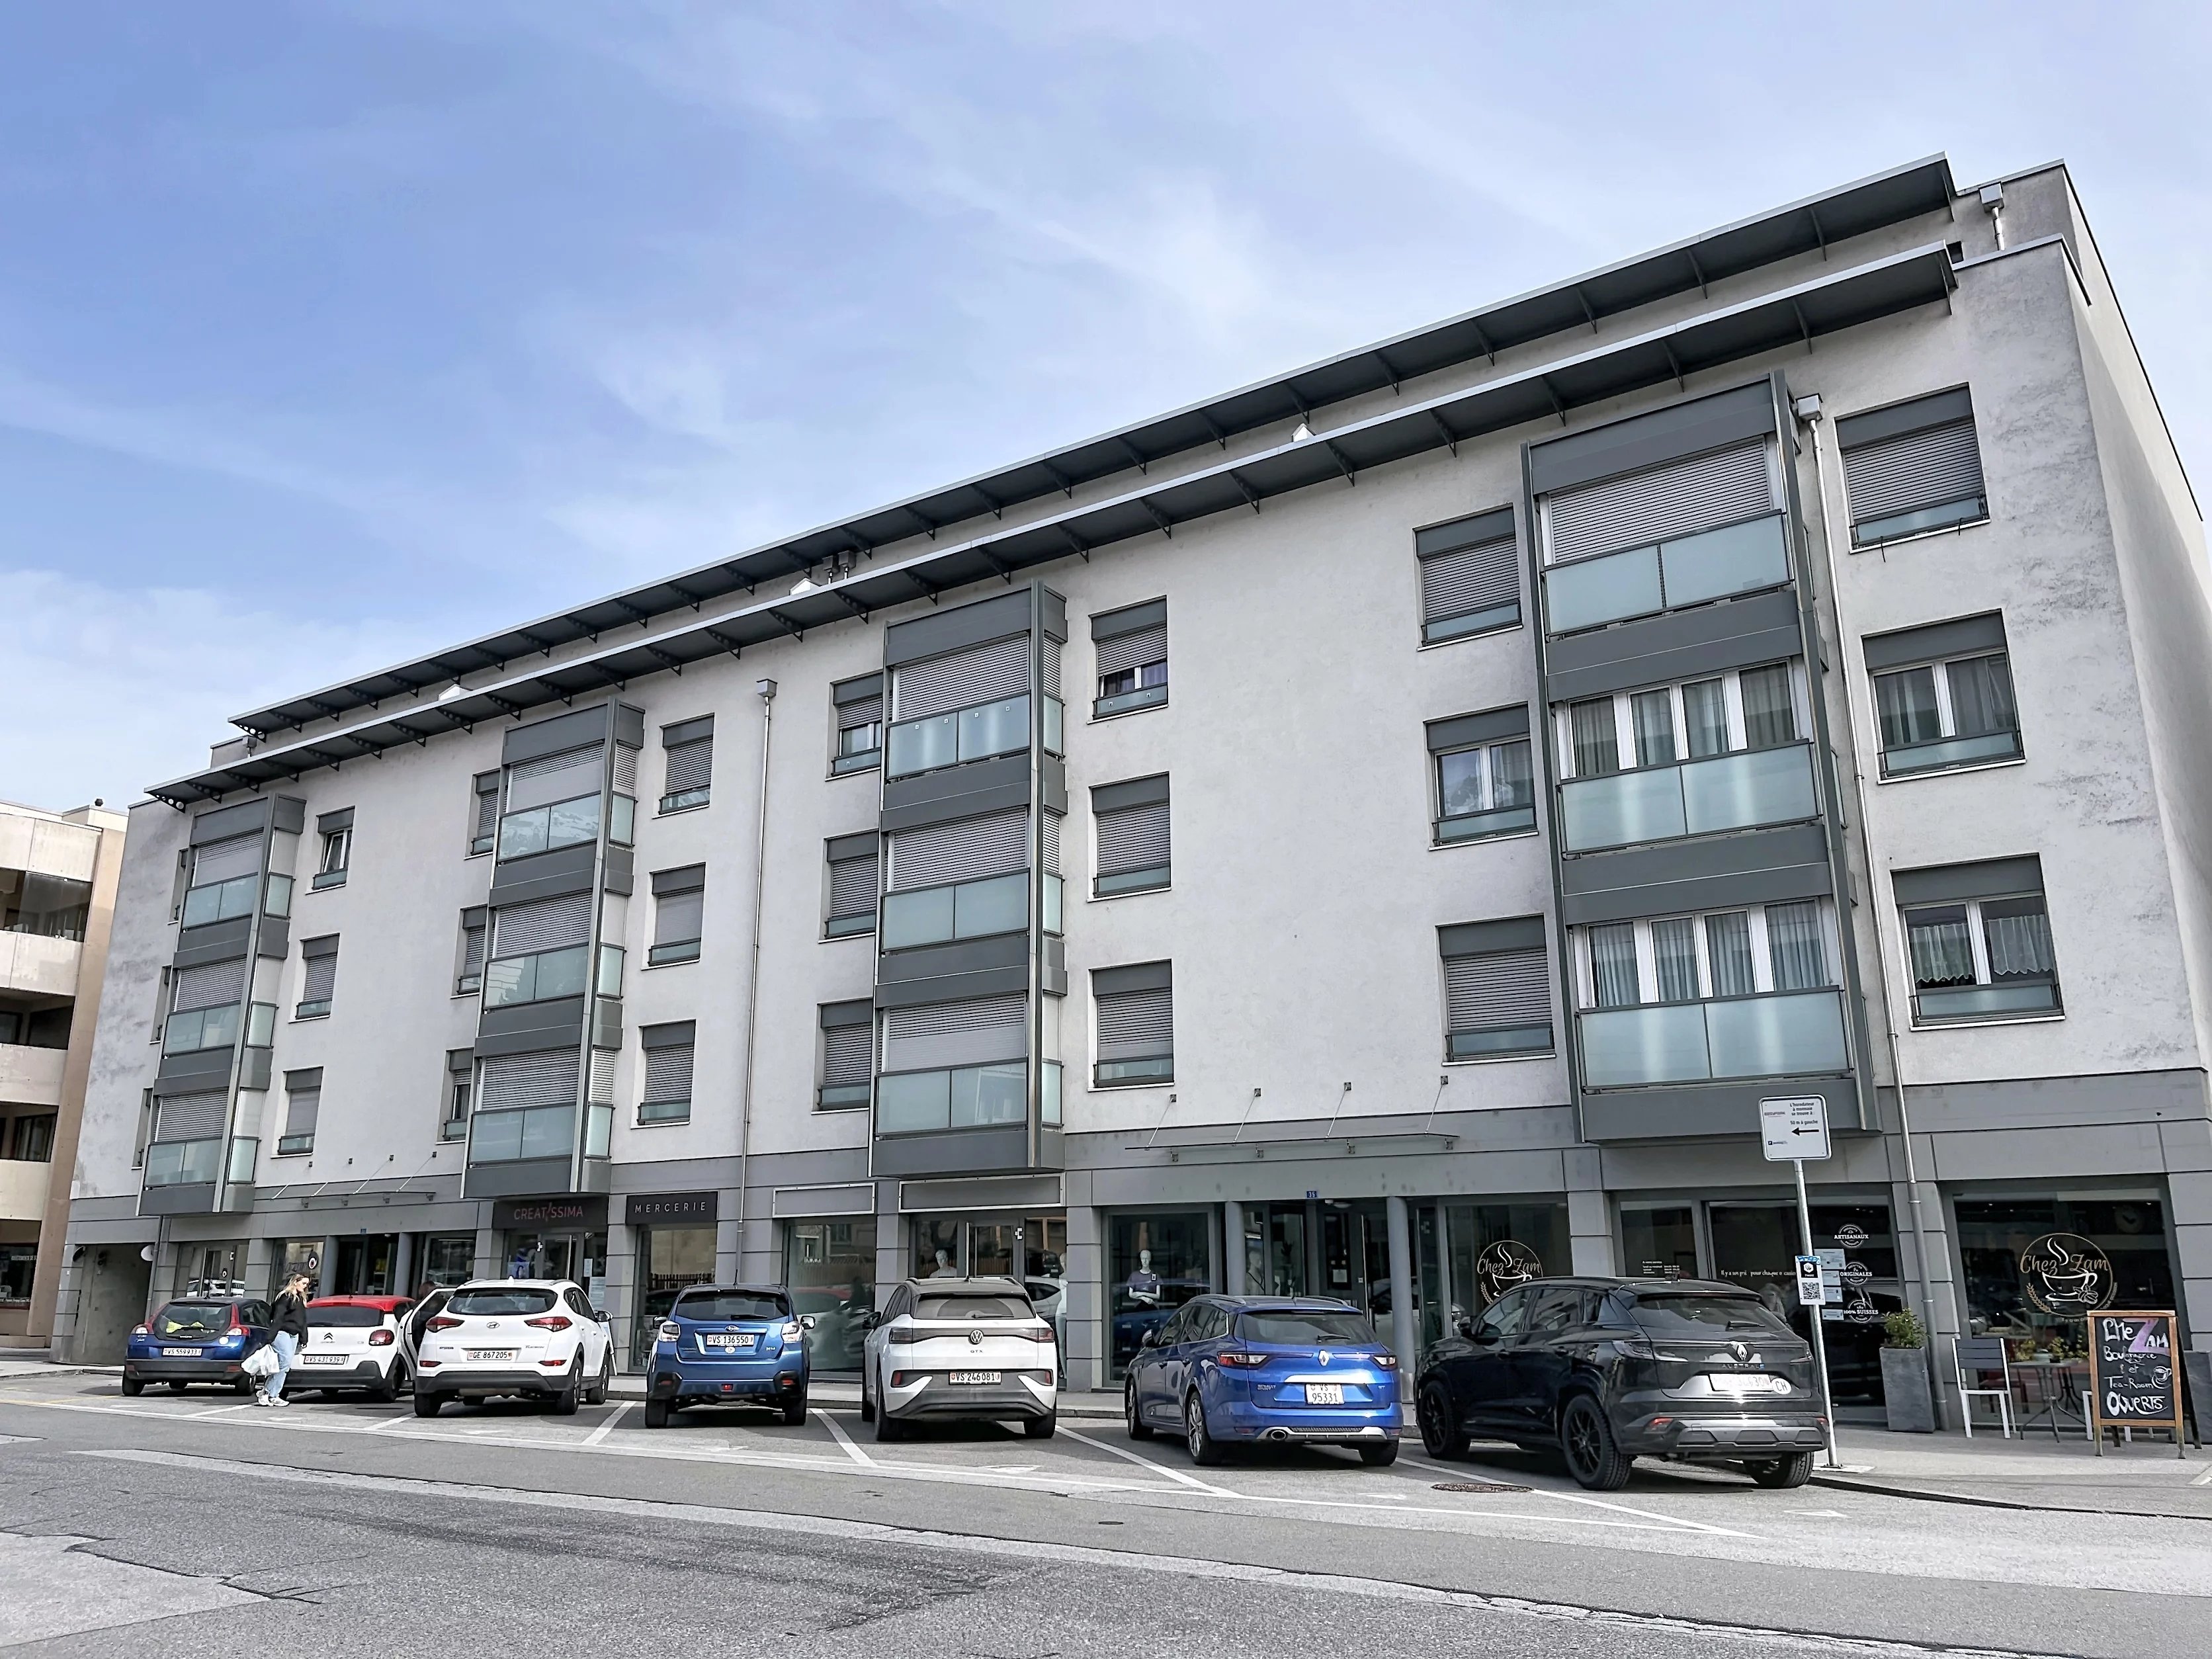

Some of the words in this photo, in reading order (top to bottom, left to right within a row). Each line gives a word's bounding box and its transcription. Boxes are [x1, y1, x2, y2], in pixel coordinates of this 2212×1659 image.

[635, 1202, 706, 1213] MERCERIE
[1477, 1258, 1504, 1277] Chez
[1512, 1257, 1540, 1275] Zam
[2020, 1255, 2058, 1277] Chez
[2069, 1254, 2109, 1274] Zam
[713, 1336, 721, 1344] VS
[2129, 1364, 2139, 1374] et
[956, 1373, 965, 1381] VS
[1319, 1383, 1328, 1392] VS
[1775, 1381, 1788, 1392] CH
[2104, 1376, 2154, 1389] Tea-Room
[1312, 1392, 1338, 1402] 95331
